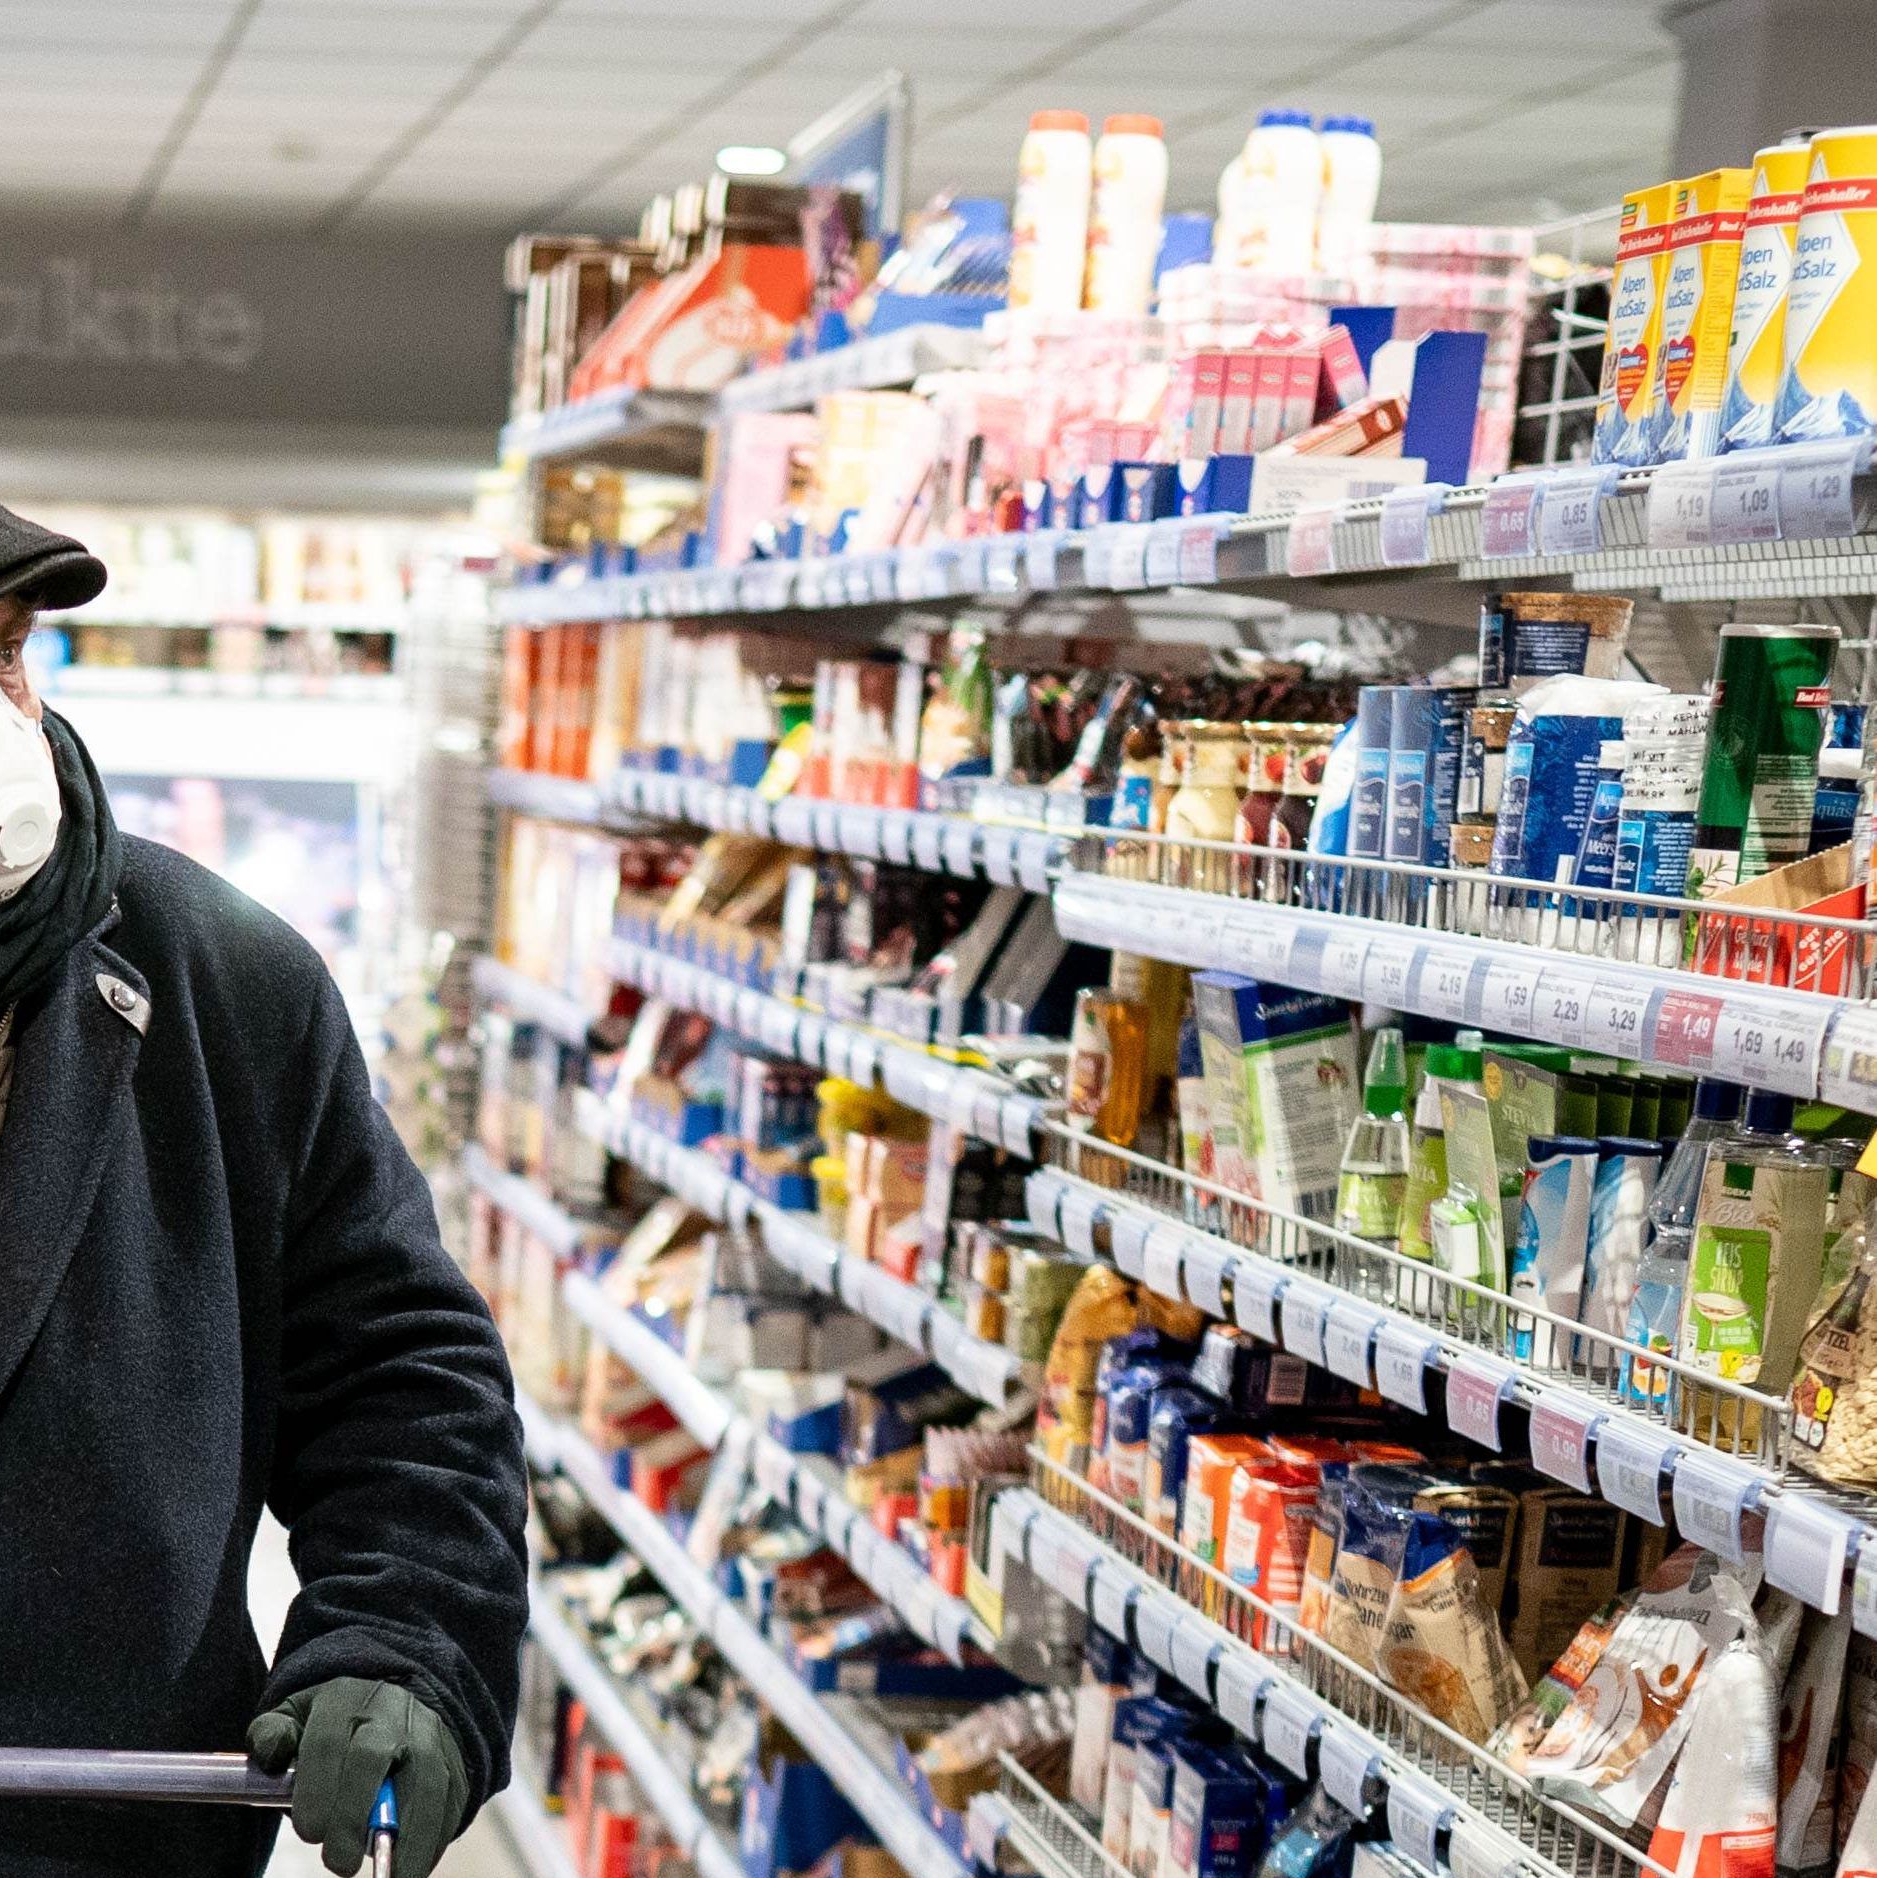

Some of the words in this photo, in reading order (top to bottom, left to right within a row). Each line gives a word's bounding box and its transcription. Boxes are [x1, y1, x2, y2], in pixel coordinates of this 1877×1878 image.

[1719, 221, 1737, 231] Bad
[1742, 247, 1773, 265] lpen
[1623, 277, 1646, 294] Alpen
[1673, 266, 1694, 282] Alpen
[1739, 272, 1777, 291] dSalz
[1615, 300, 1646, 320] JodSalz
[1809, 474, 1841, 500] 1,29
[1561, 503, 1588, 524] 0,85
[1675, 492, 1704, 519] 1,19
[1739, 490, 1769, 515] 1,09
[1500, 511, 1524, 534] 0,65
[1797, 691, 1812, 703] Bad
[1439, 974, 1461, 996] 2,19
[1504, 986, 1529, 1009] 1,59
[1553, 998, 1580, 1022] 2,29
[1608, 1007, 1636, 1032] 3,29
[1682, 1012, 1712, 1038] 1,49
[1734, 1027, 1763, 1056] 1,69
[1774, 1035, 1806, 1064] 1,49
